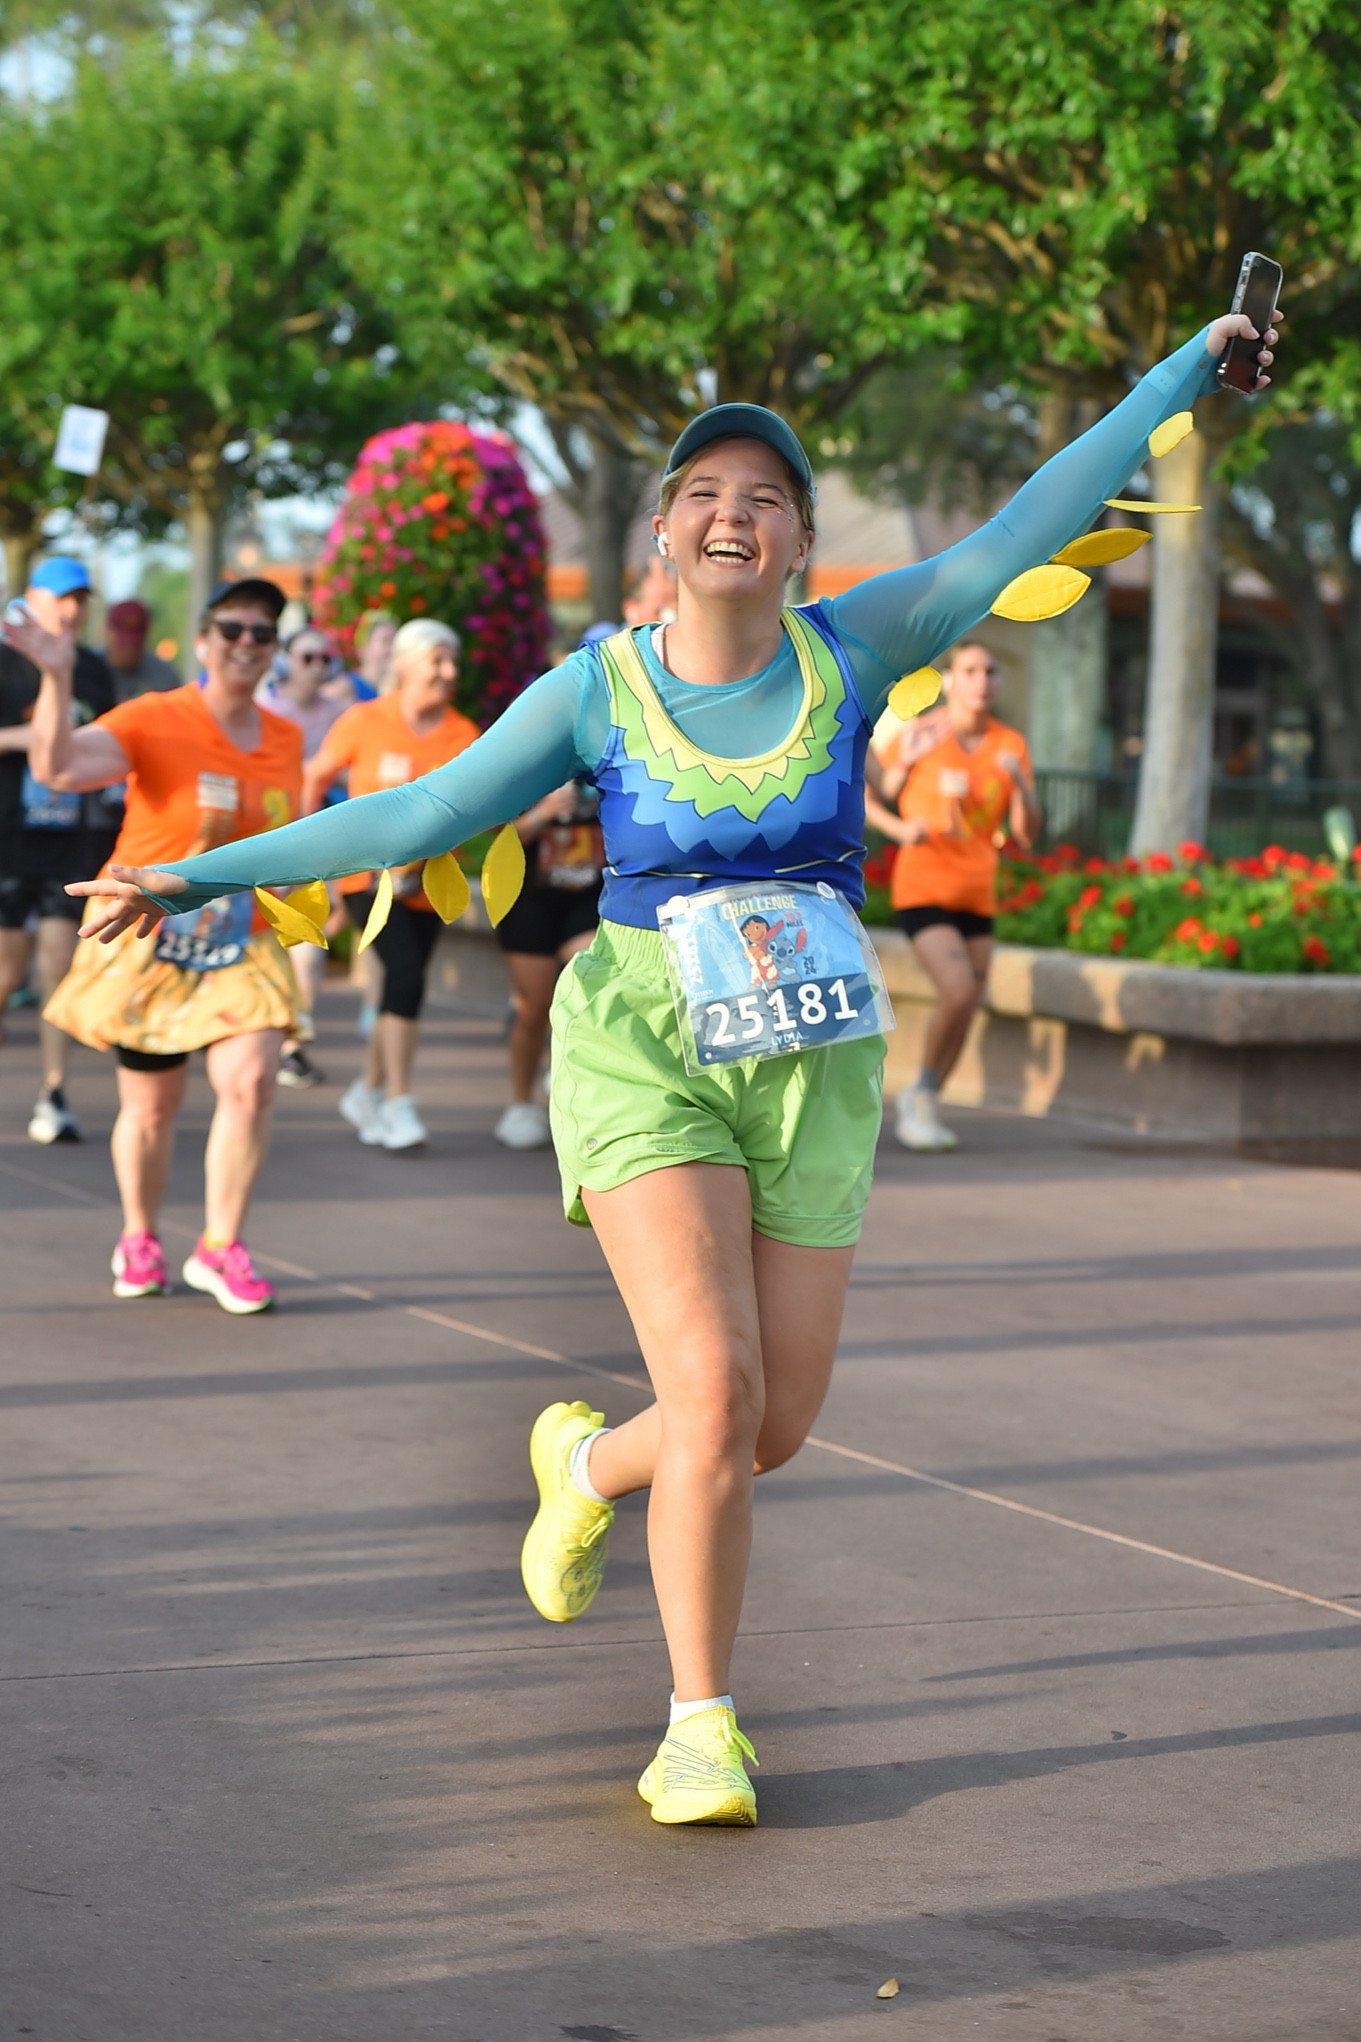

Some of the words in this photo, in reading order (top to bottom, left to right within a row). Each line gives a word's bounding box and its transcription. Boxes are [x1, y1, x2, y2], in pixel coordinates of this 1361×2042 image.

[721, 895, 798, 921] CHALLENGE
[803, 956, 815, 966] 20
[804, 965, 817, 975] 24
[706, 979, 859, 1047] 25181
[770, 1032, 804, 1048] LYDIA
